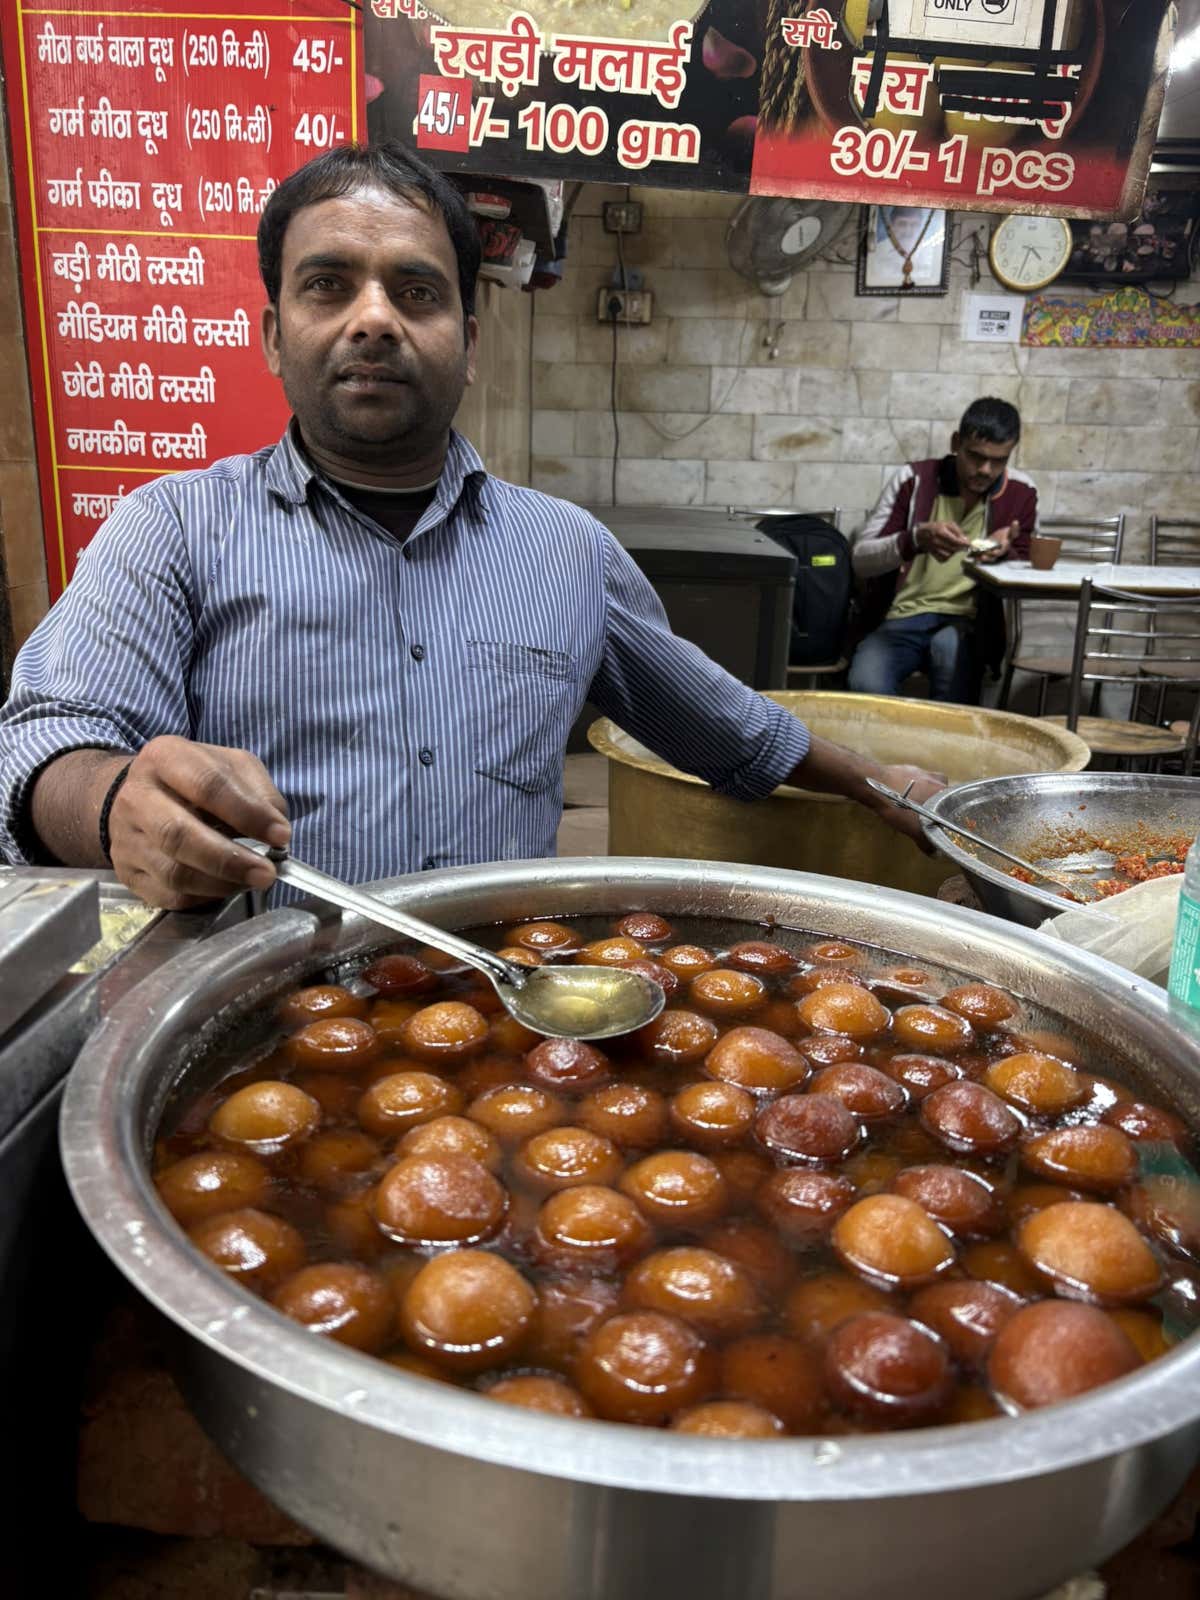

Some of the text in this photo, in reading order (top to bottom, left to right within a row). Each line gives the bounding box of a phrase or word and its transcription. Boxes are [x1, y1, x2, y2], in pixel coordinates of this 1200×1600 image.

[36, 20, 344, 83] मीठा बर्फ वाला दूध (250 मि.ली) 45/-
[781, 9, 842, 50] सपै.
[431, 11, 692, 108] रबड़ी मलाई
[48, 95, 345, 155] गर्म मीठा दूध (250 मि.ली) 40/-
[418, 88, 466, 137] 45/-
[518, 100, 609, 156] 100
[617, 119, 700, 169] gm
[829, 126, 1075, 195] 30/- 1 pcs
[46, 167, 84, 209] गर्म
[87, 168, 141, 210] फीका
[151, 180, 183, 227] दूध
[197, 175, 233, 223] (250
[52, 241, 206, 294] बड़ी मीठी लस्सी
[56, 300, 251, 347] मीडियम मीठी लस्सी
[61, 360, 217, 404] छोटी मीठी लस्सी
[66, 419, 208, 460] नमकीन लस्सी
